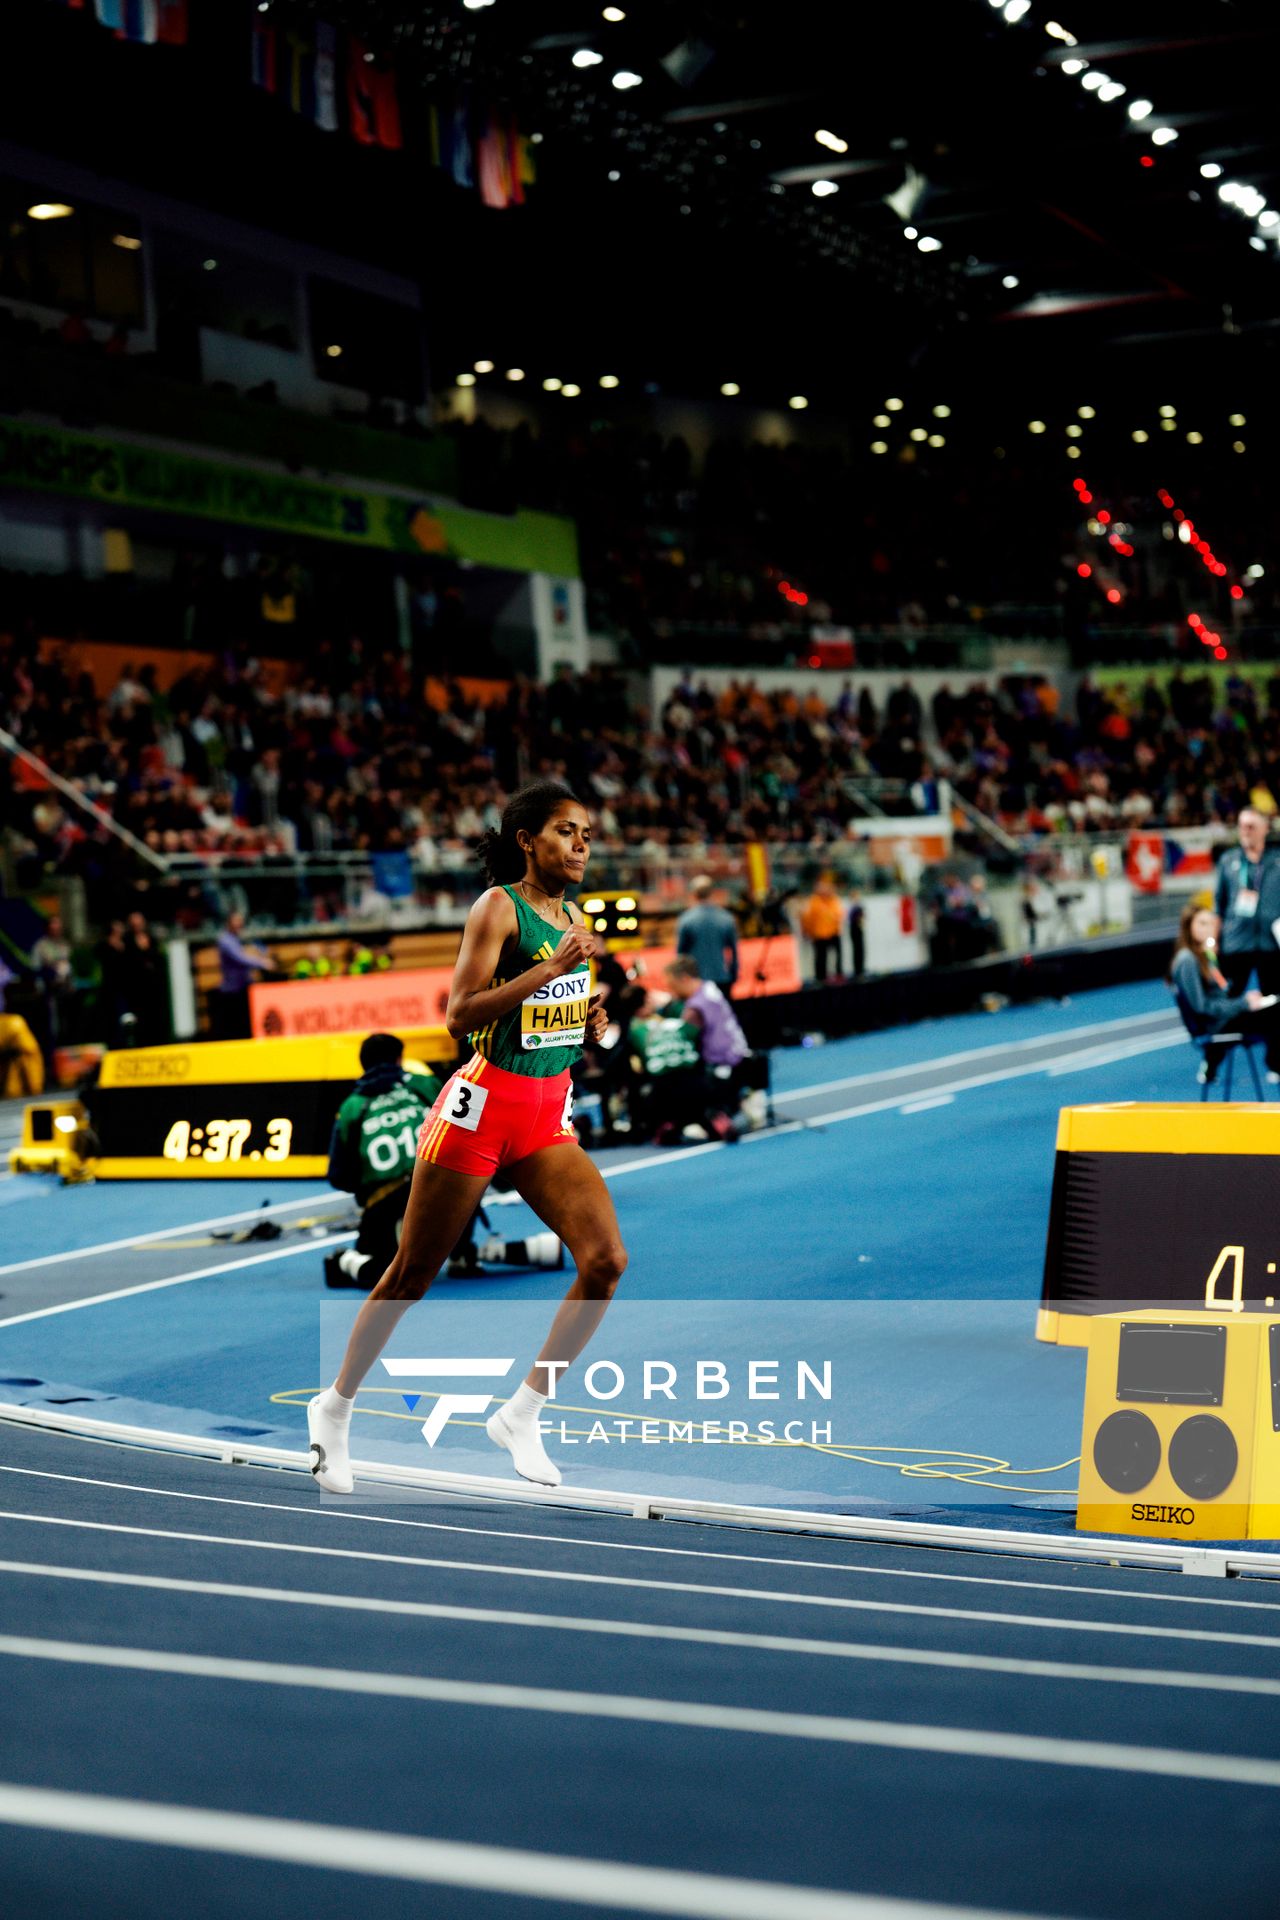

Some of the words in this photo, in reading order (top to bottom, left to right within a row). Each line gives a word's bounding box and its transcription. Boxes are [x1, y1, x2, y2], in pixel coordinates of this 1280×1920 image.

[533, 977, 587, 1000] SONY
[532, 1001, 587, 1028] HAILU
[451, 1086, 472, 1119] 3
[163, 1117, 294, 1164] 4:37.3
[366, 1124, 422, 1172] 01
[1131, 1503, 1195, 1525] SEIKO
